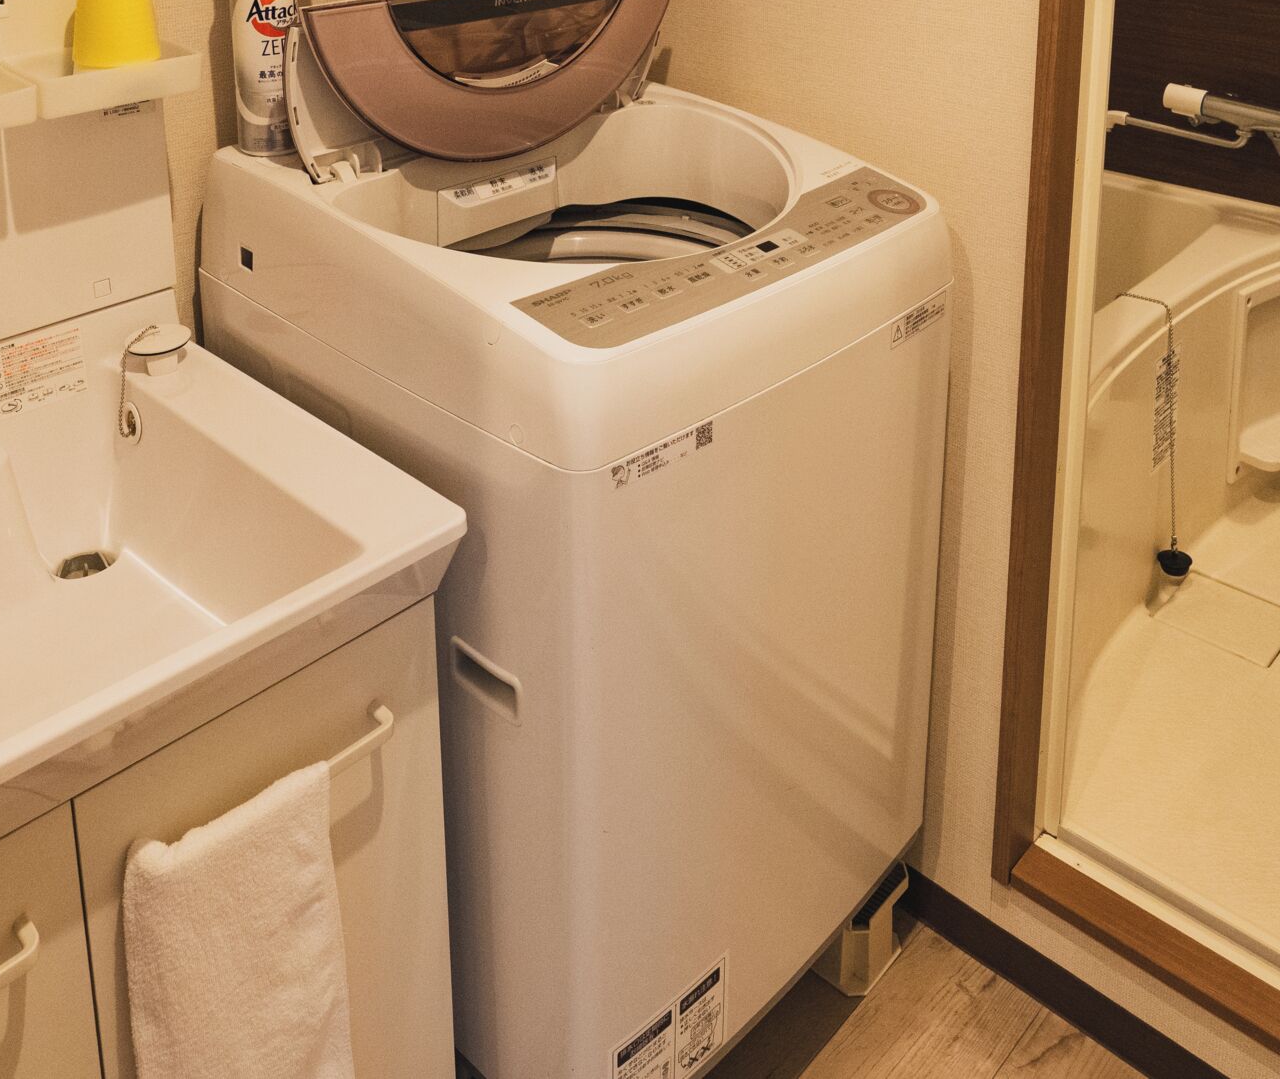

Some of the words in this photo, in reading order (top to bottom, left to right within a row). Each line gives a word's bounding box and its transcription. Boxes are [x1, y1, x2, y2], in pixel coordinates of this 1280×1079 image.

[589, 272, 634, 289] 7.0kg
[531, 289, 572, 307] SHARP
[620, 297, 644, 310] すすぎ
